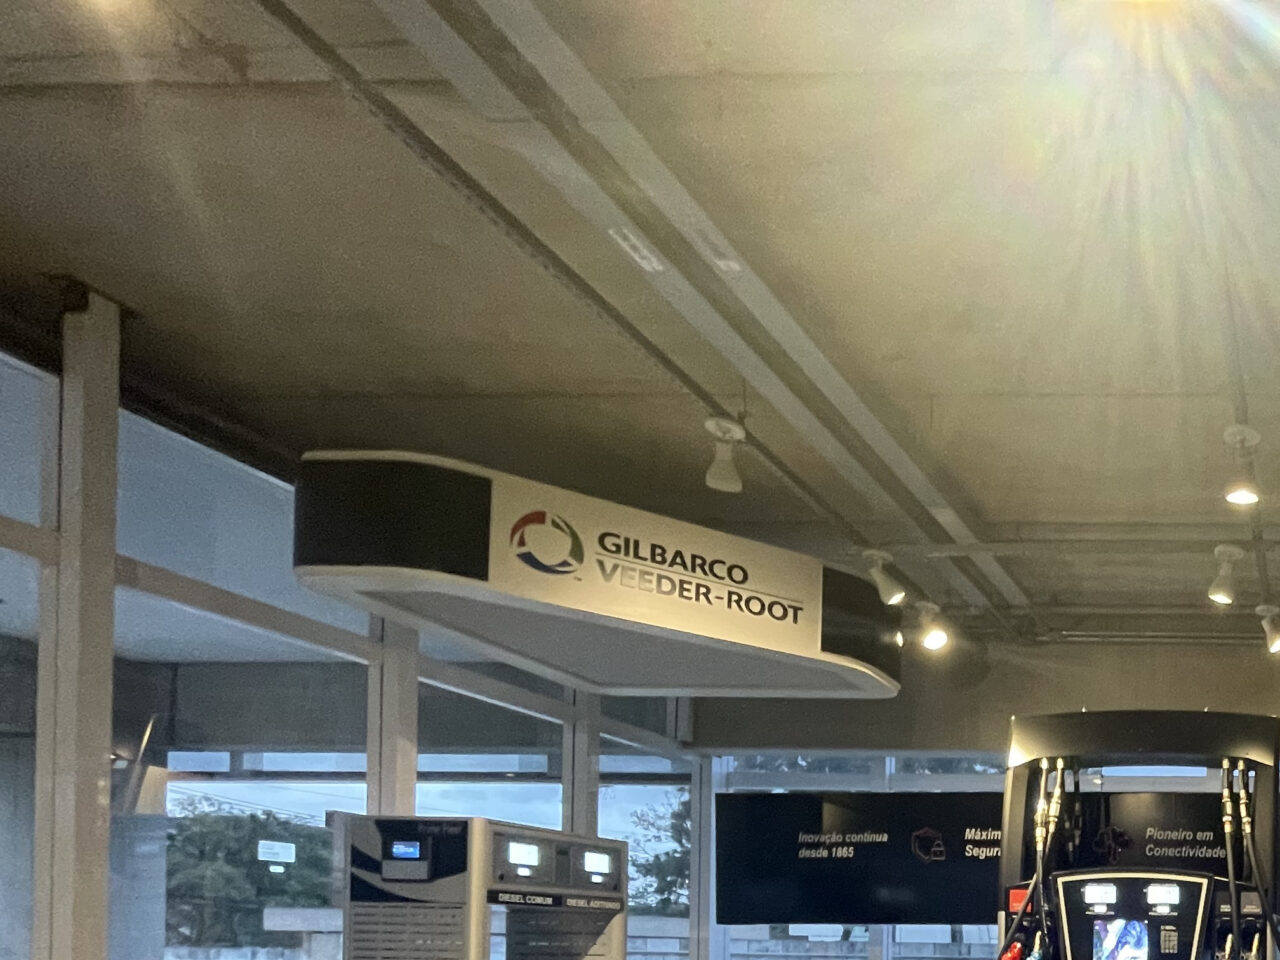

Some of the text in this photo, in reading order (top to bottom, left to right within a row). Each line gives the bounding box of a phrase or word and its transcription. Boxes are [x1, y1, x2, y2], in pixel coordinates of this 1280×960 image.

[597, 532, 749, 585] GILBARCO
[596, 558, 804, 625] VEEDER-ROOT
[798, 831, 842, 846] Inovação
[965, 827, 1002, 840] Máxim
[1145, 827, 1214, 841] Pioneiro em
[798, 846, 855, 859] desde 1865
[1145, 844, 1227, 858] Conectividade
